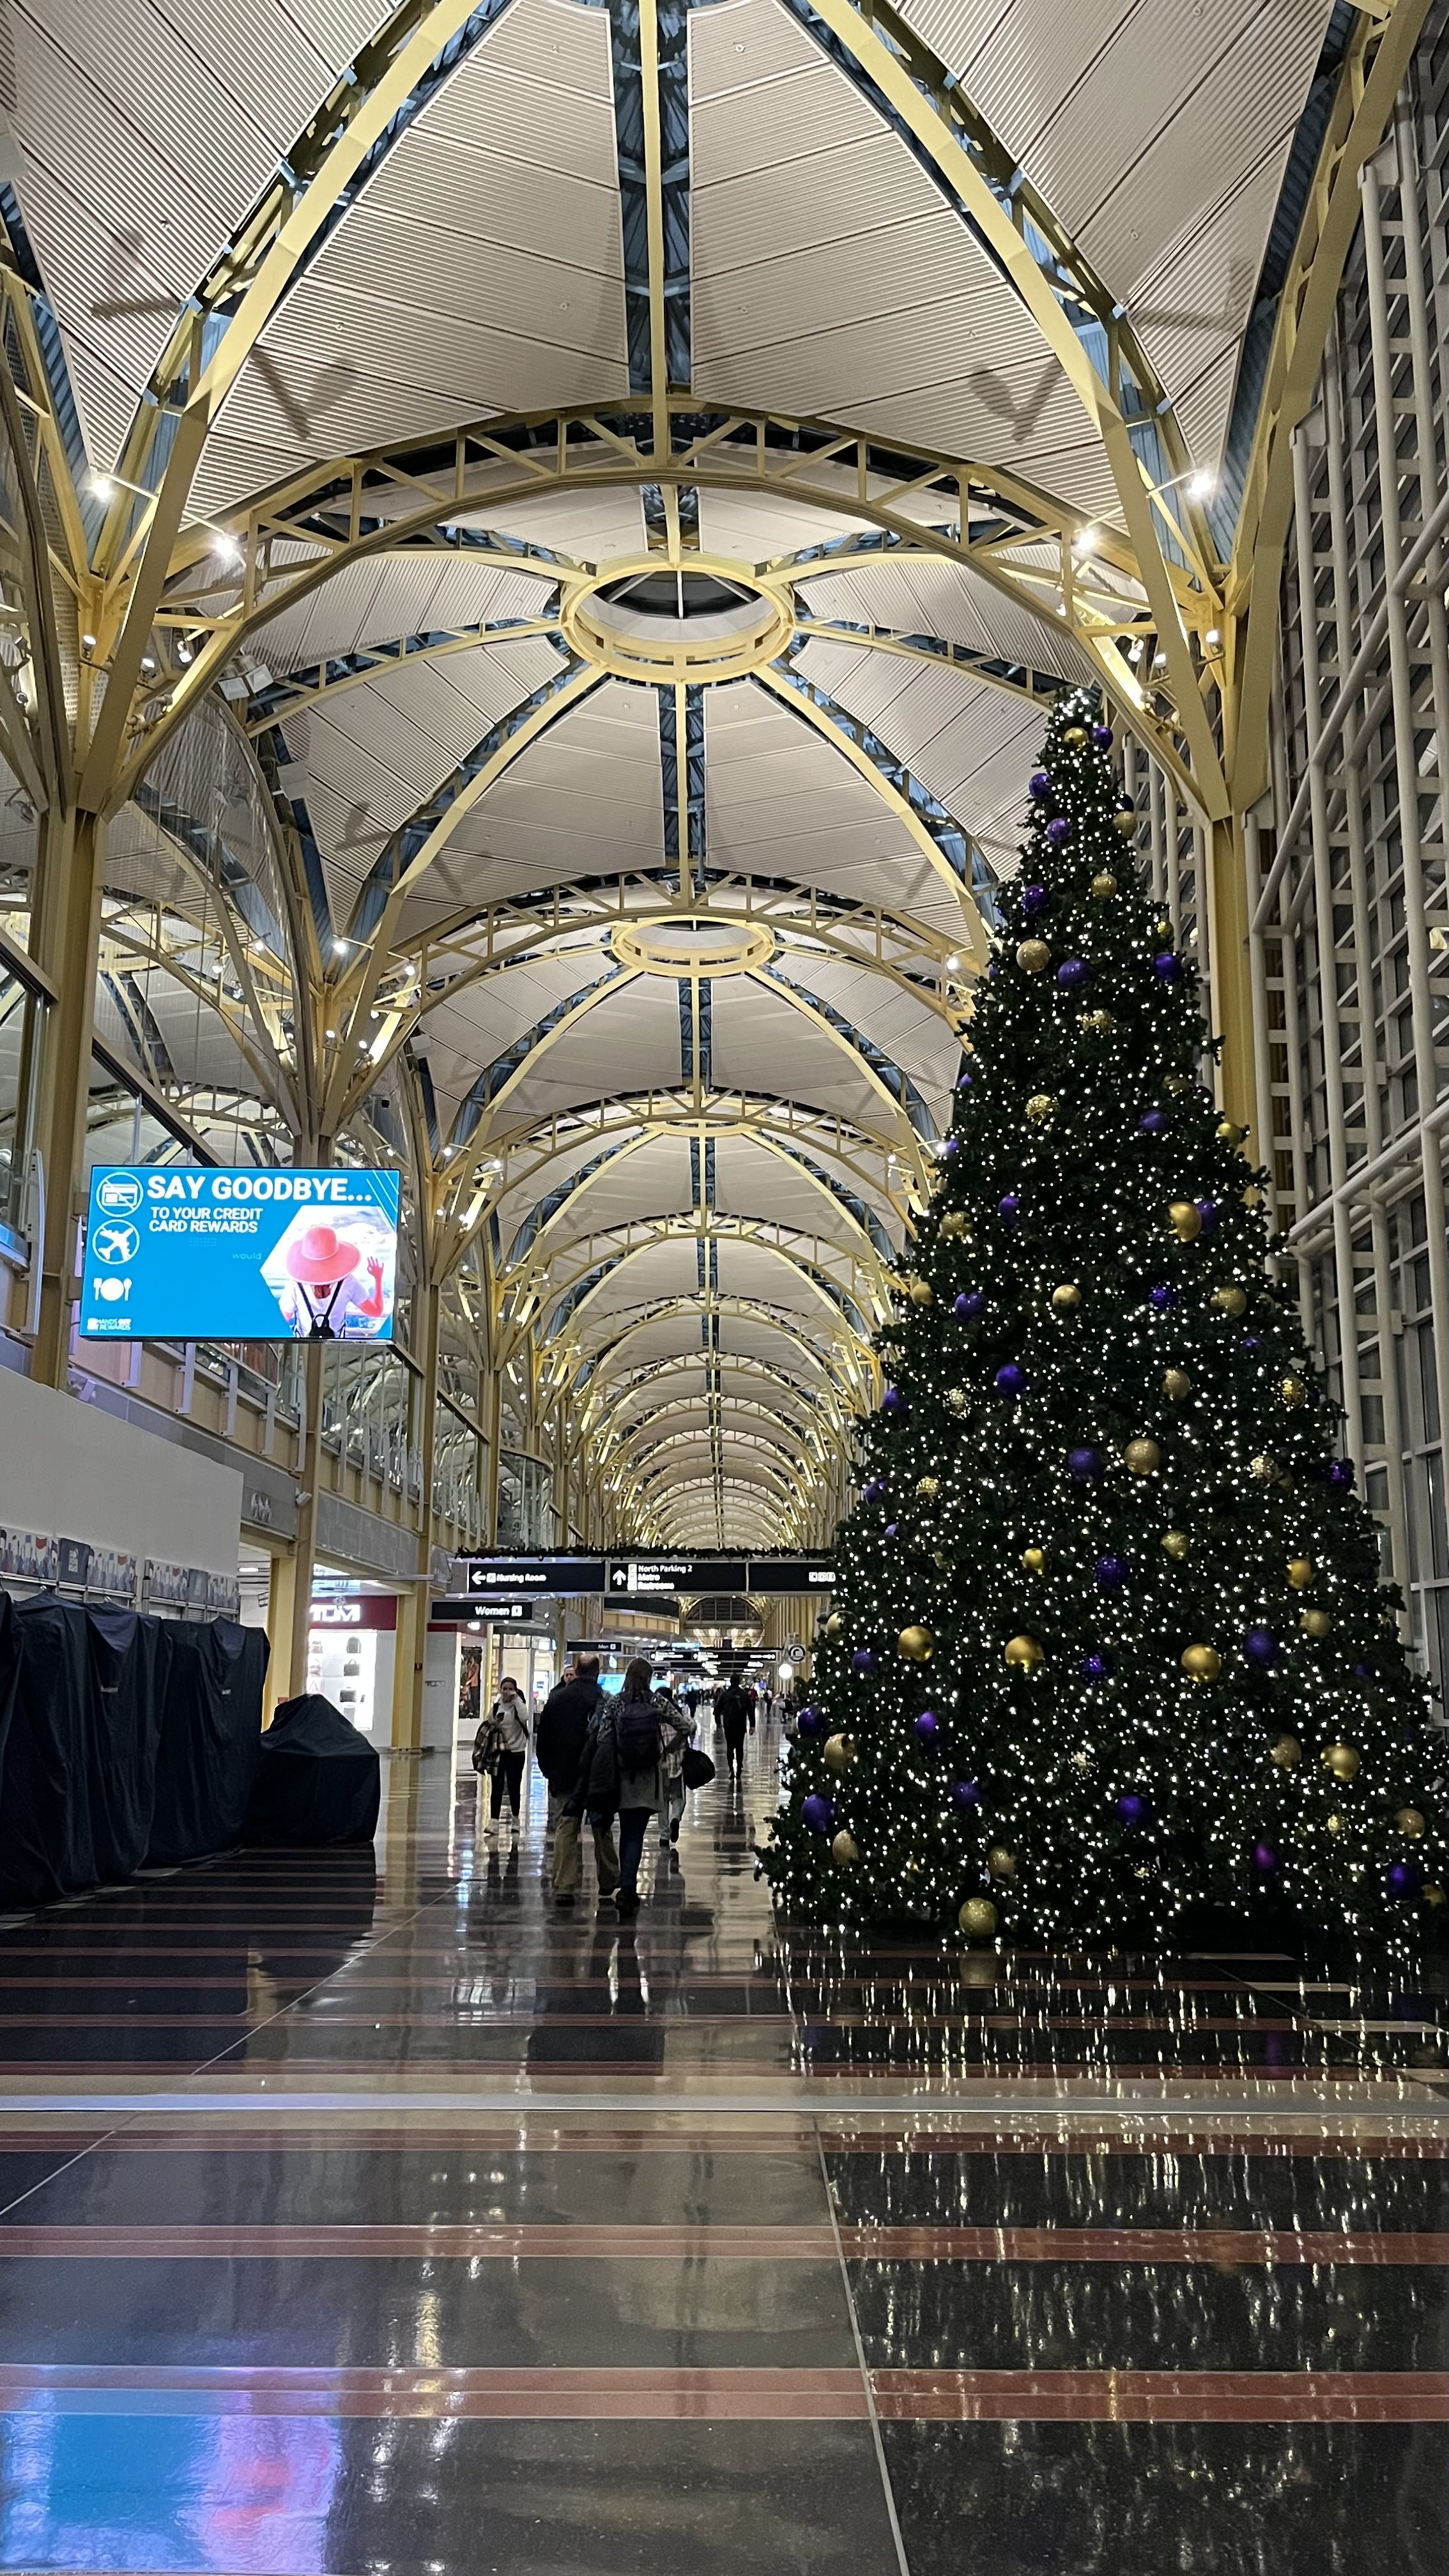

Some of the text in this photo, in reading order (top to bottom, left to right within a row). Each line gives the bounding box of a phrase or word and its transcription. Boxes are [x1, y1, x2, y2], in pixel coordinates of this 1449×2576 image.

[147, 1175, 372, 1202] SAY GOODBYE...
[150, 1206, 264, 1220] TO YOUR CREDIT
[149, 1219, 258, 1234] CARD REWARDS
[232, 1252, 262, 1261] would
[638, 1564, 693, 1574] North Parking 2
[496, 1573, 548, 1584] Nursing Room
[475, 1606, 510, 1616] Women
